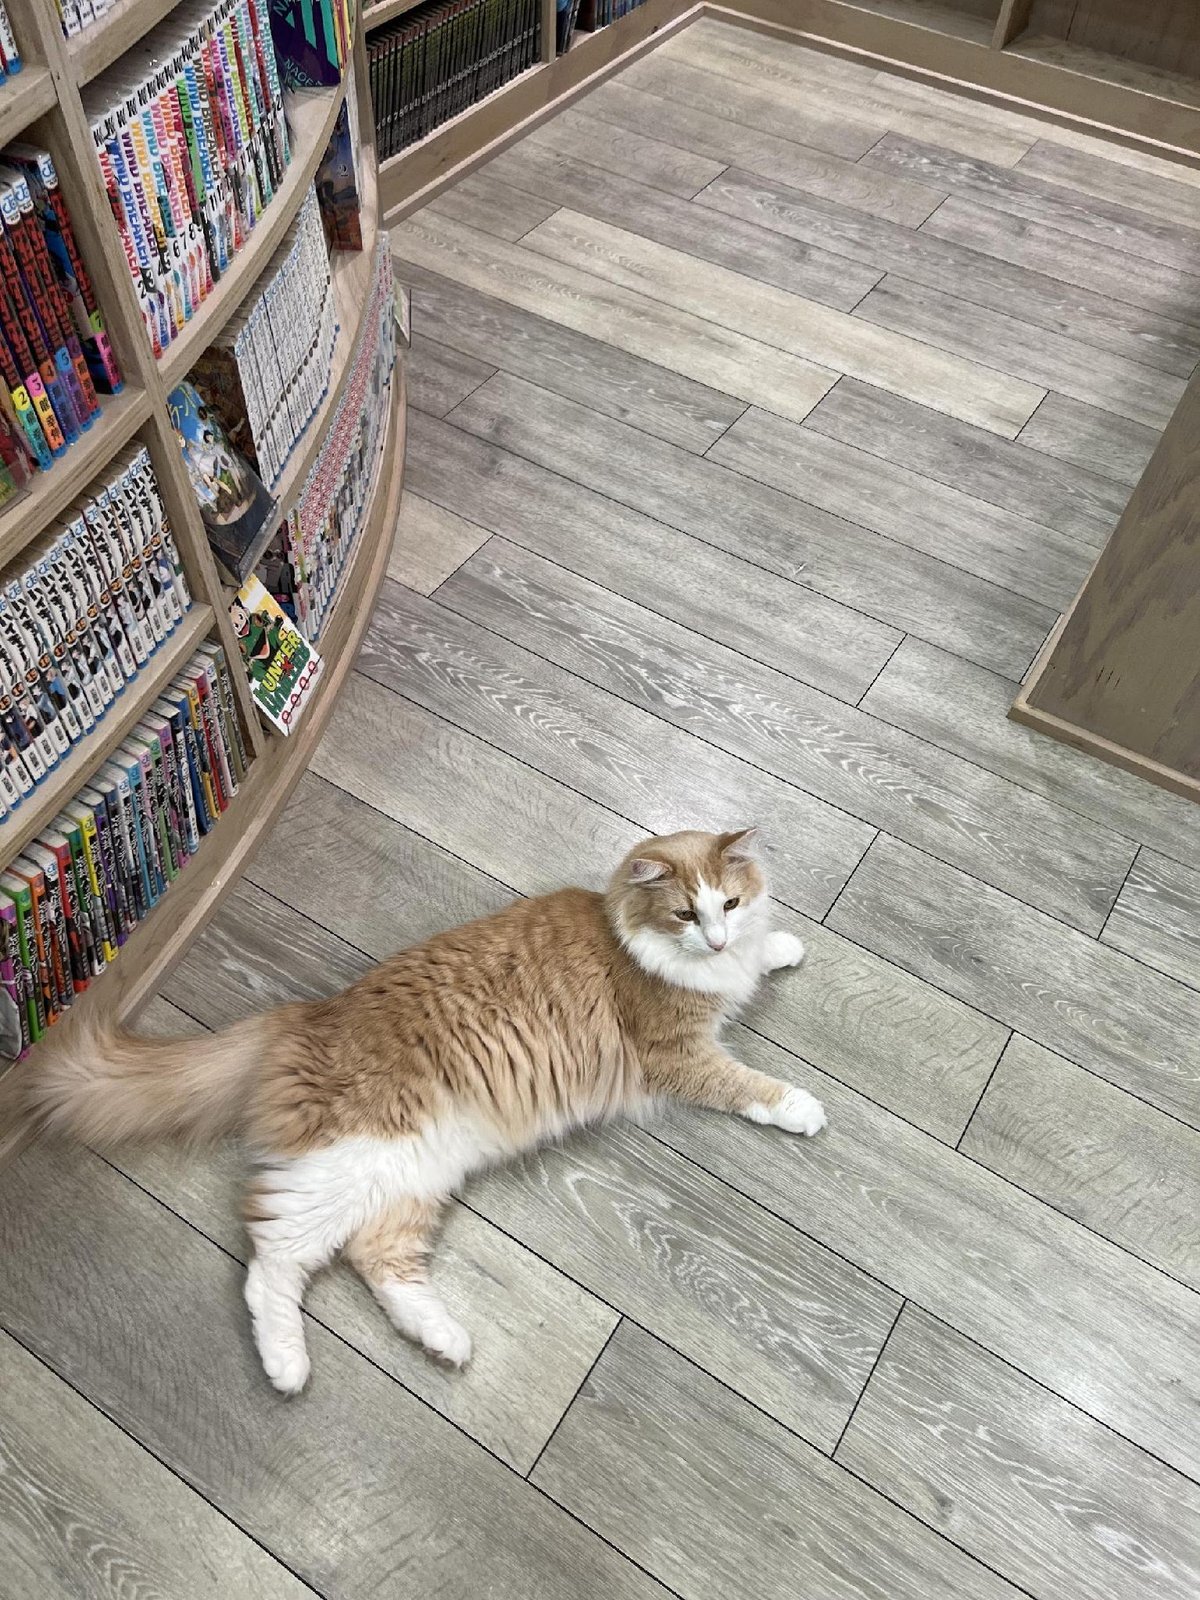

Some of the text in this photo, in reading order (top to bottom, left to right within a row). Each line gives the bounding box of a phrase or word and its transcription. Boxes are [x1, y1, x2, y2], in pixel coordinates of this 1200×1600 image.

[217, 31, 230, 73] WIND
[184, 66, 200, 111] WIND
[142, 111, 159, 156] WIND
[151, 103, 168, 148] WIND
[193, 56, 209, 101] WIND
[201, 107, 220, 181] BREAKER
[131, 122, 148, 167] WIND
[159, 95, 176, 139] WIND
[169, 145, 192, 219] BREAKER
[122, 131, 158, 258] WIND BREAKER
[123, 190, 150, 267] BREAKER
[173, 240, 180, 258] 6
[180, 231, 187, 250] 7
[189, 223, 196, 241] 8
[137, 281, 147, 299] 2
[95, 315, 102, 328] 7
[48, 365, 54, 377] 4
[62, 353, 69, 366] 5
[18, 391, 28, 406] 2
[32, 378, 41, 391] 3
[77, 534, 106, 593] ハイキュー!!
[89, 522, 117, 580] ハイキュー!!
[52, 561, 83, 620] ハイキュー!!
[64, 548, 94, 607] ハイキュー!!
[28, 587, 60, 646] ハイキュー!!
[41, 574, 71, 632] ハイキュー!!
[11, 599, 45, 657] ハイキュー!!
